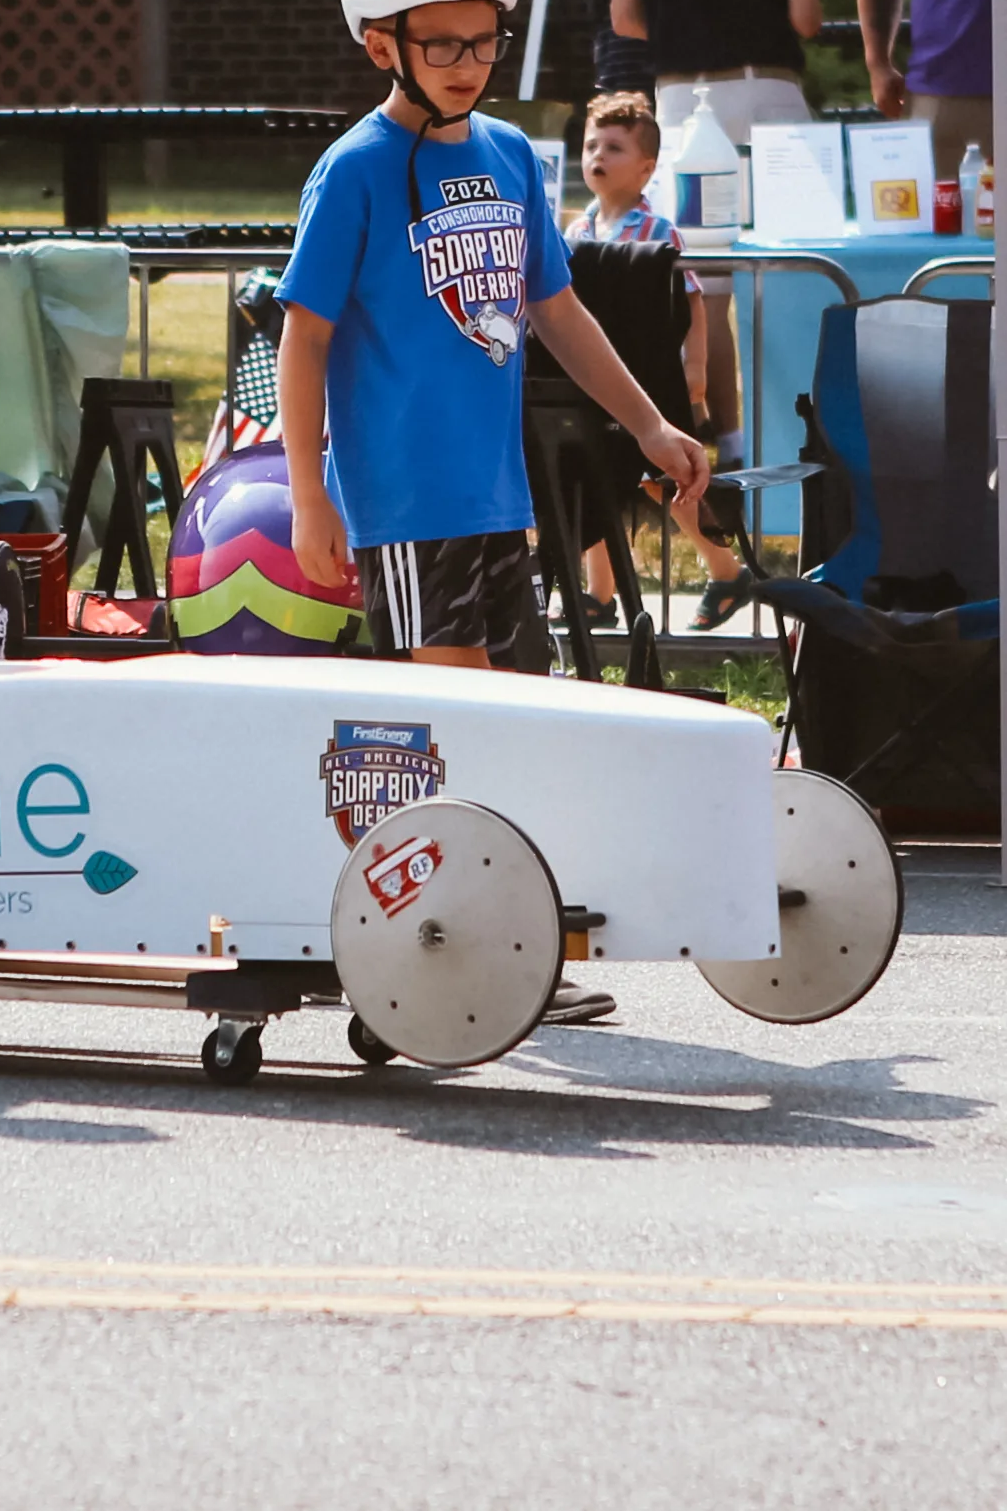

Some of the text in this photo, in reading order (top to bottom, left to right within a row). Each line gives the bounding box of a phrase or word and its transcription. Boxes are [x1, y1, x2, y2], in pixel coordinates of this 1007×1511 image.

[445, 180, 494, 202] 2024
[428, 205, 523, 235] CONSHOHOCKEN
[427, 232, 487, 284] SOAP
[464, 271, 517, 303] DERBY
[352, 726, 414, 745] FirstEnergy
[332, 770, 430, 807] SOAP BOX
[411, 856, 429, 879] RF
